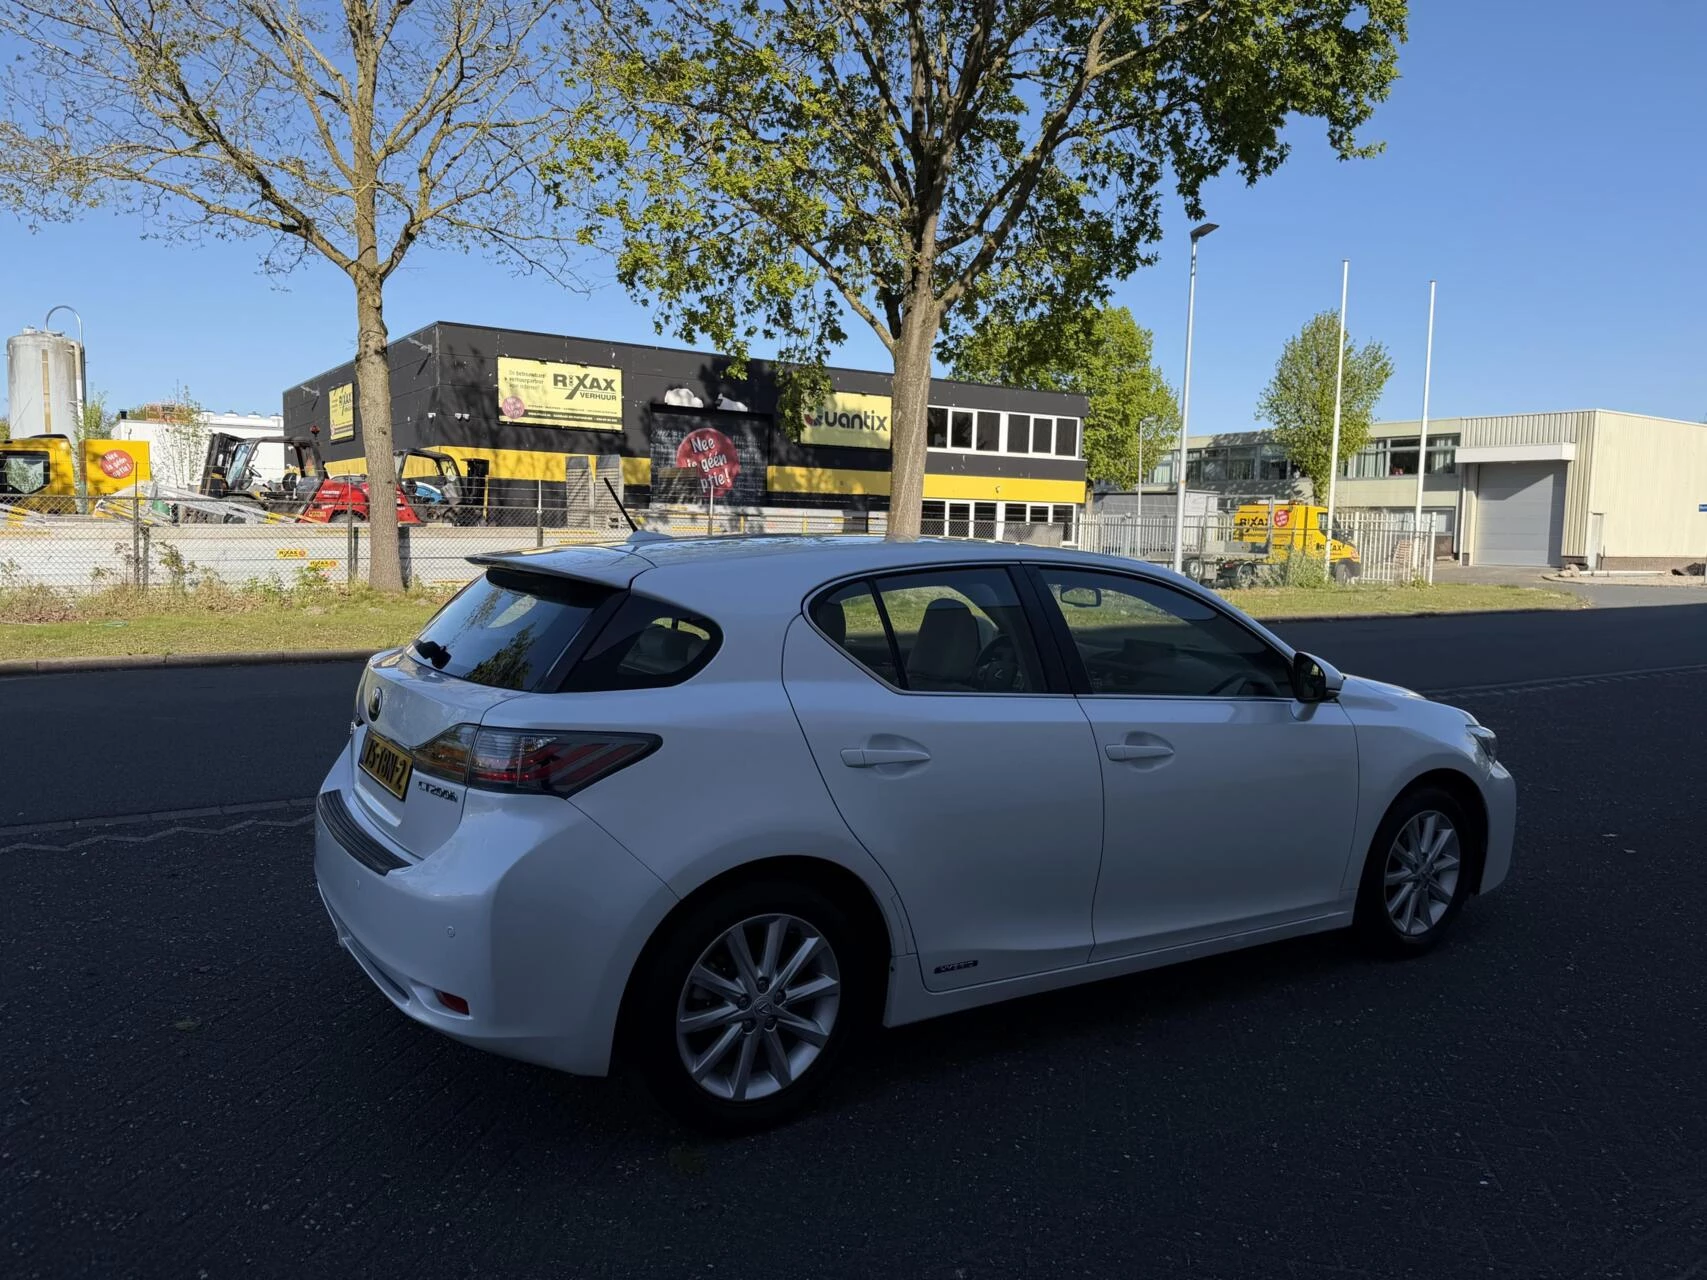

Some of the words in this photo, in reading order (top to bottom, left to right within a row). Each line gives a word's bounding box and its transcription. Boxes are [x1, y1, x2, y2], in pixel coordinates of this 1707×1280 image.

[580, 392, 617, 401] VERHUUR
[691, 437, 715, 453] Nee
[700, 451, 727, 472] géén
